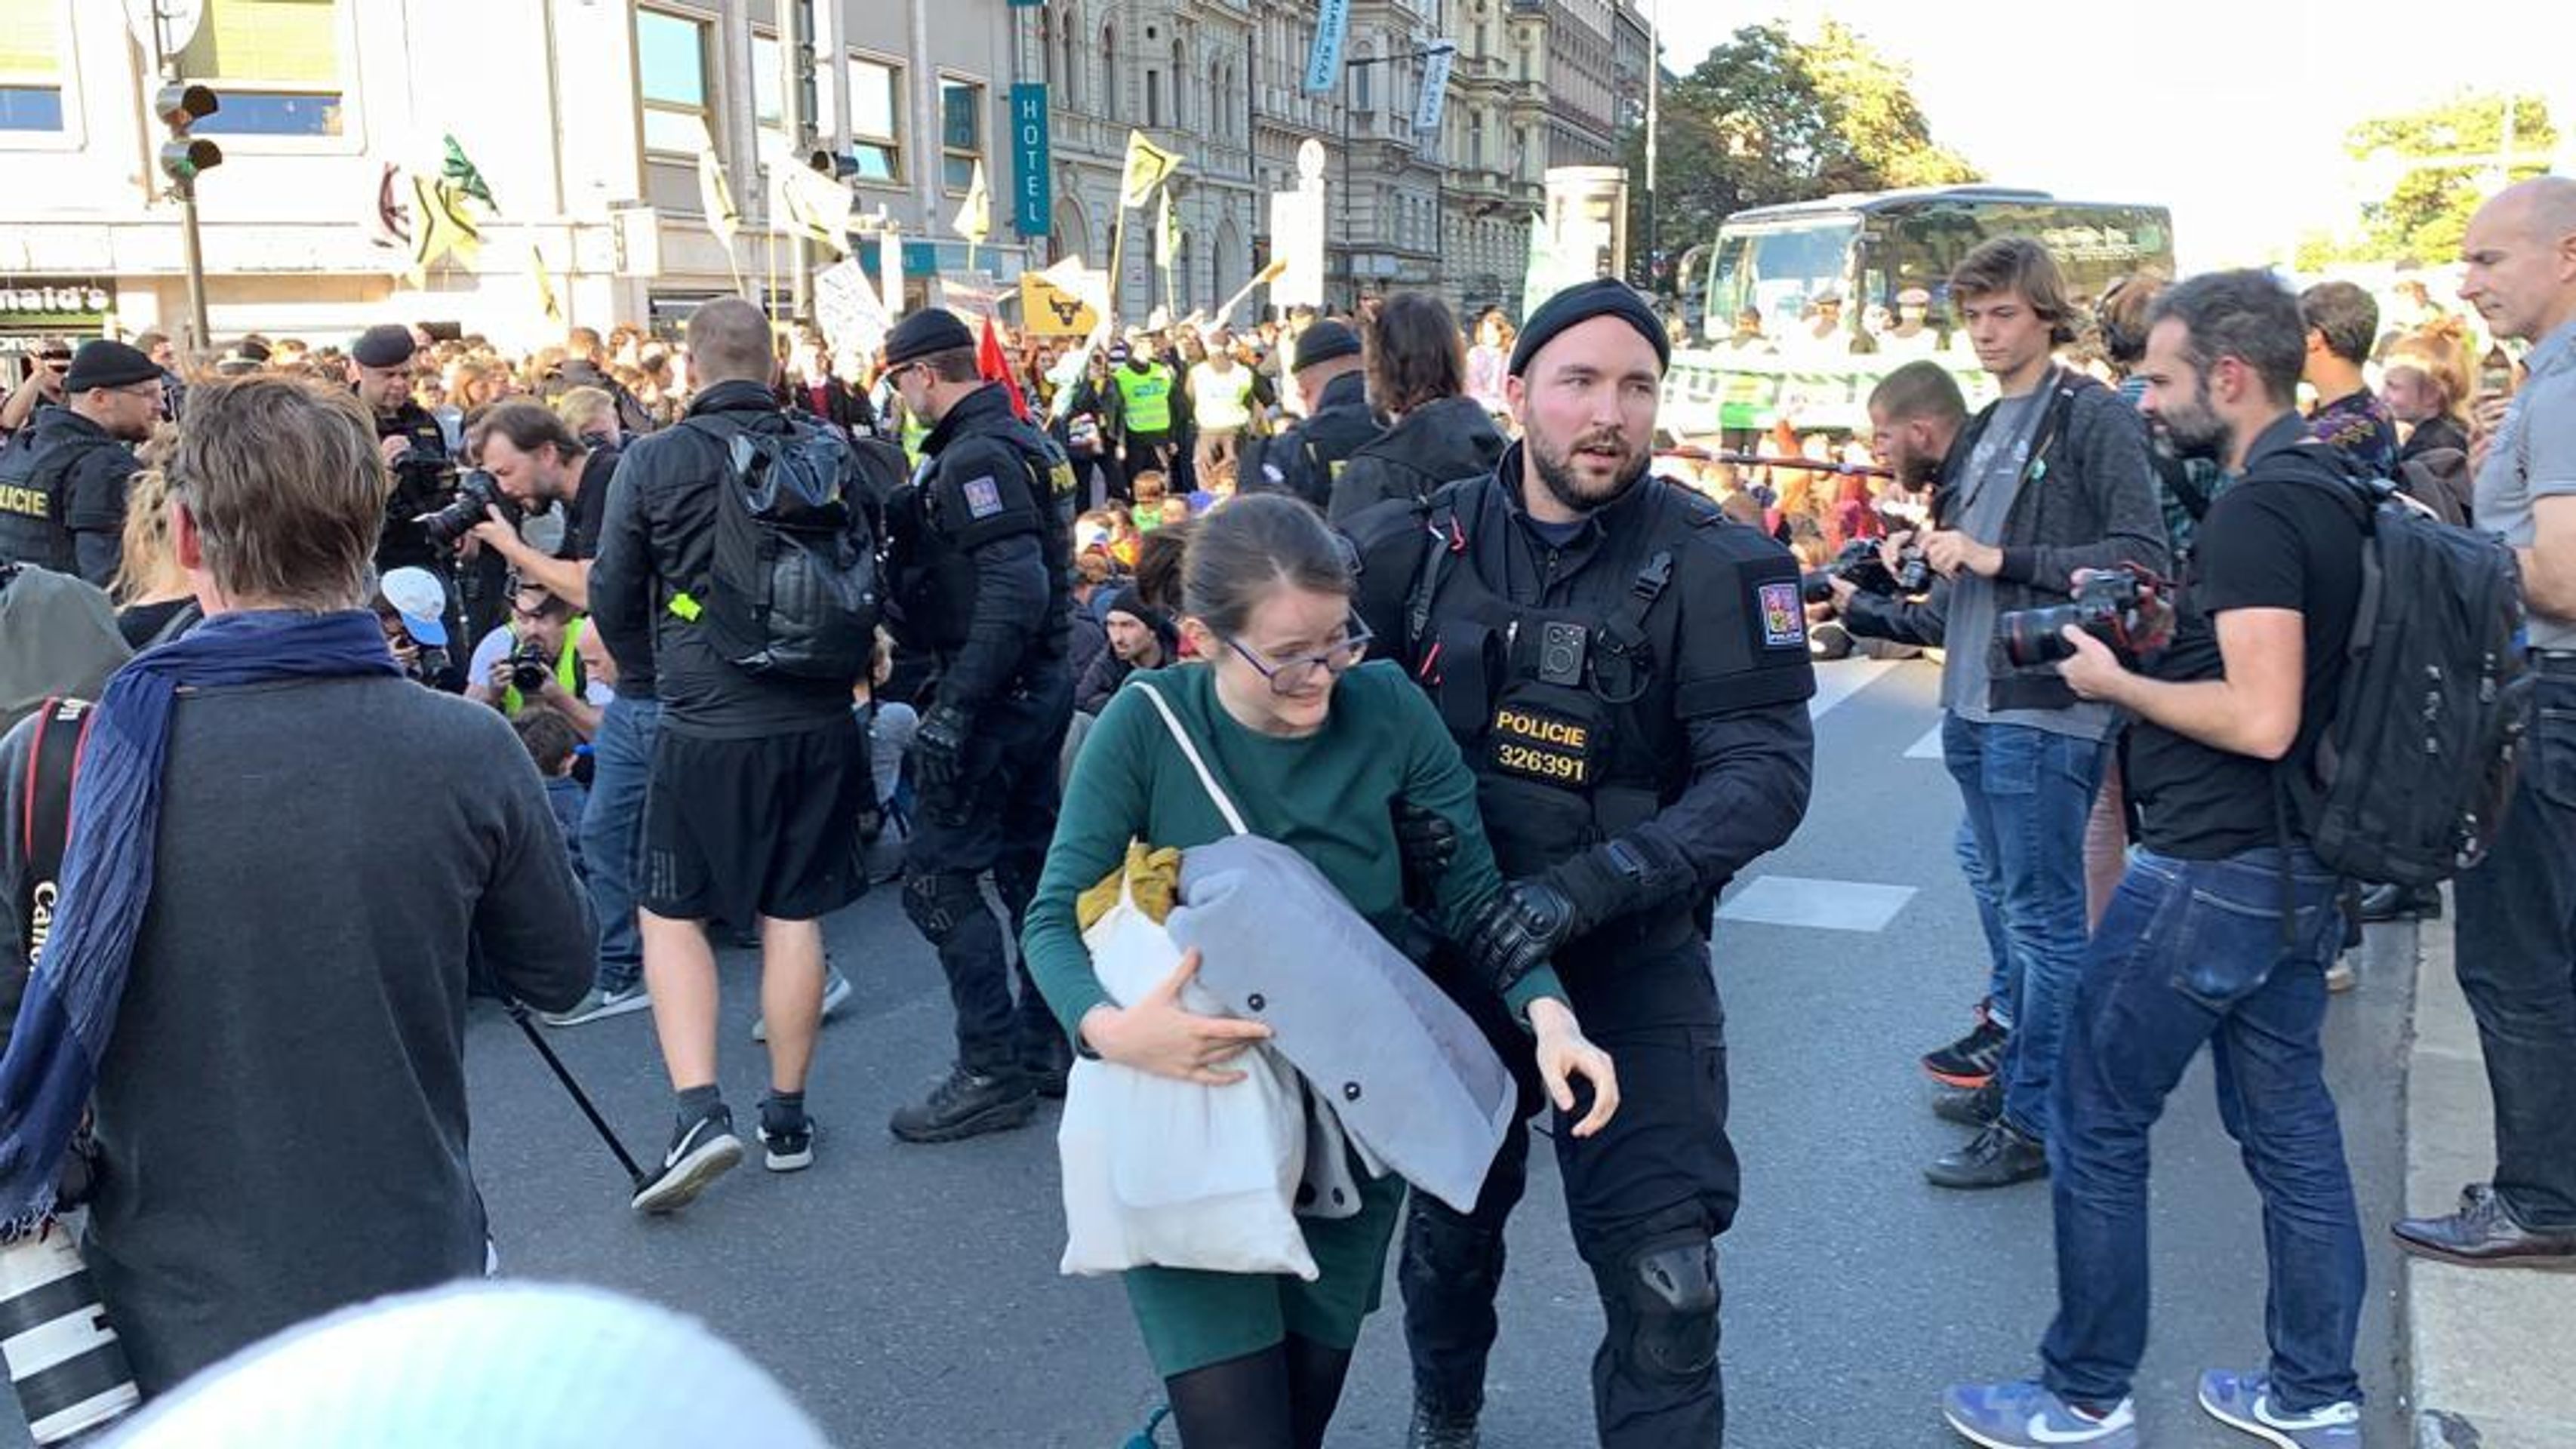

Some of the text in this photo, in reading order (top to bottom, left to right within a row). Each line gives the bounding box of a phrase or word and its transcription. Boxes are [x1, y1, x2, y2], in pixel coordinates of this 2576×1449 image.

[1023, 100, 1039, 222] HOTEL
[1497, 711, 1586, 747] POLICIE
[1499, 744, 1583, 780] 326391
